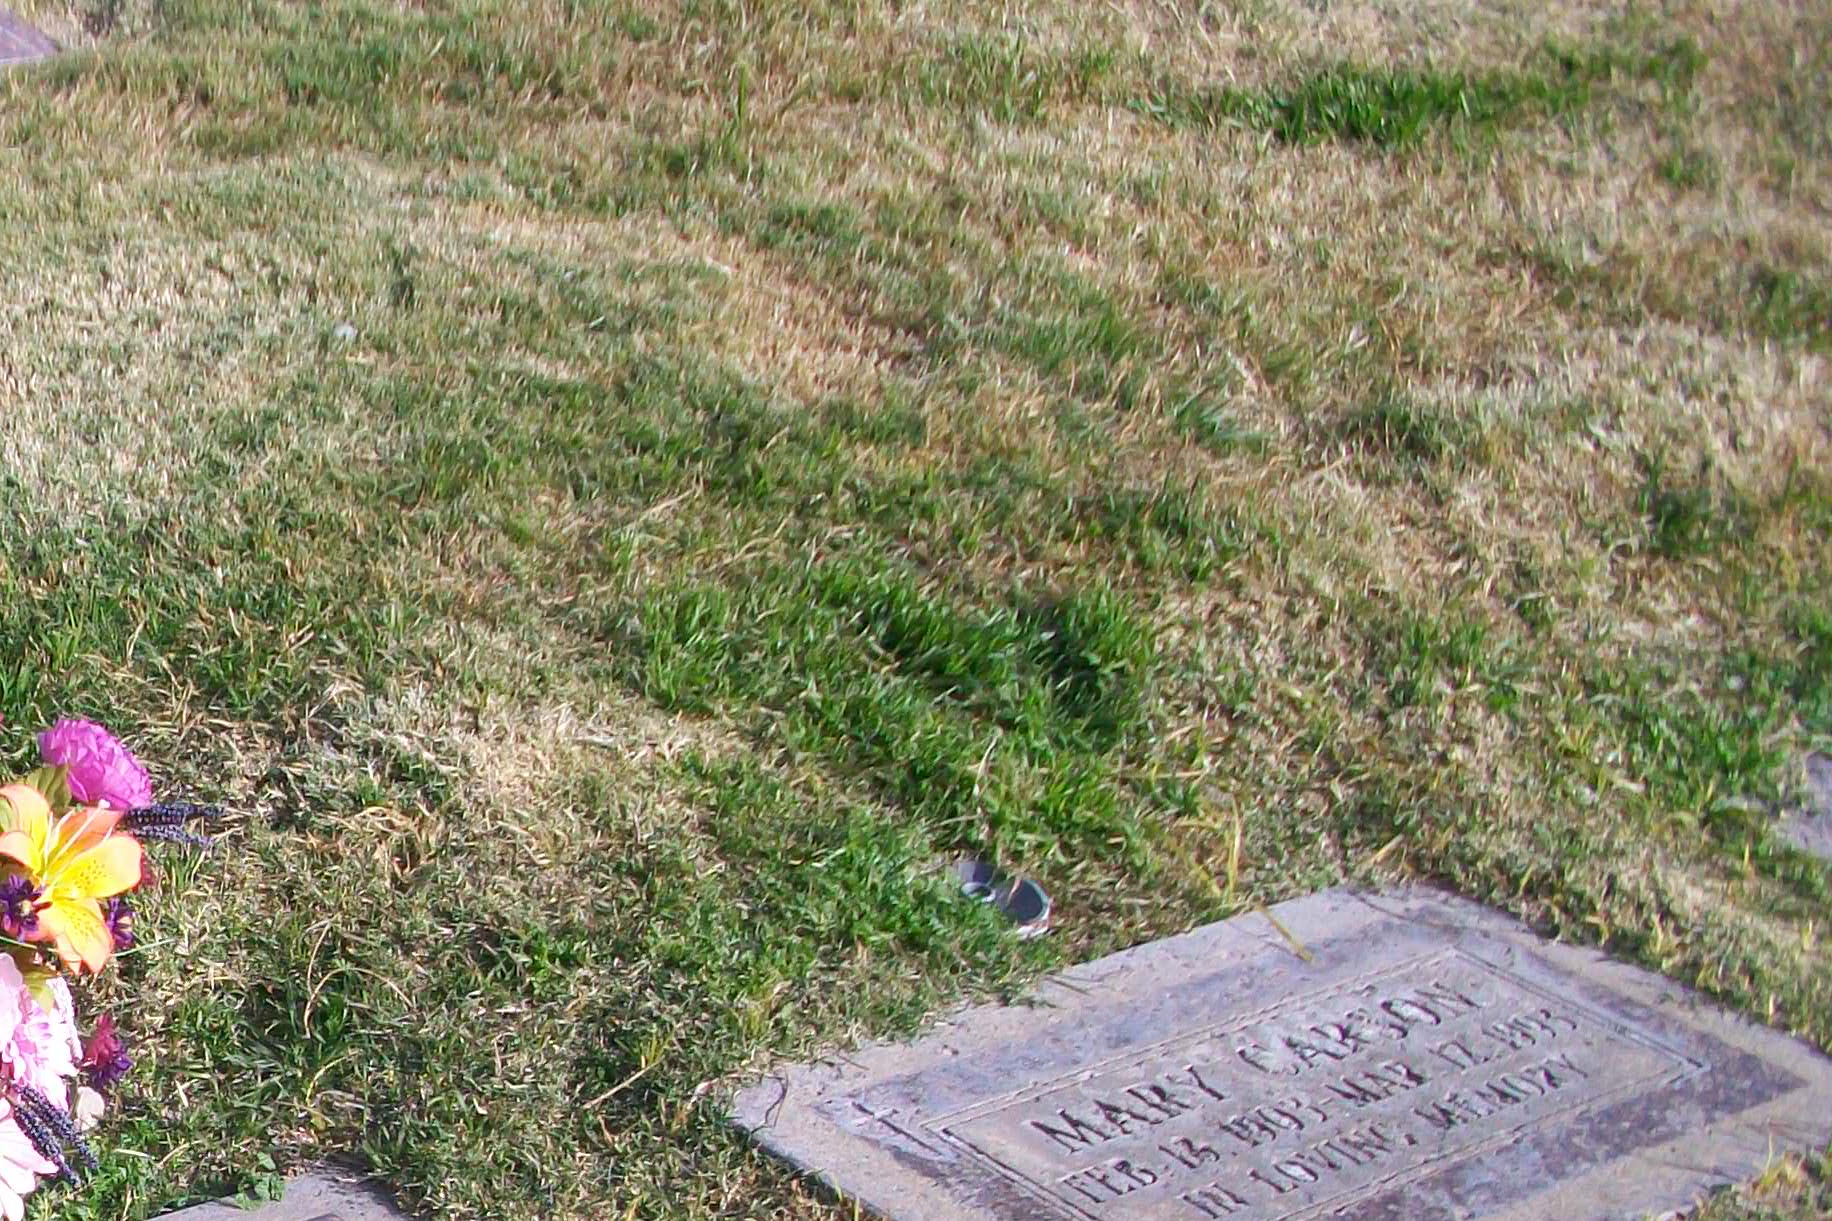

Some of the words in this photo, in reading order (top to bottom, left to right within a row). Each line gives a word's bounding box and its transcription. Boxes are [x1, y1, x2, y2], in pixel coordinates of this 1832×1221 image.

[1030, 1063, 1226, 1154] MARY
[1237, 980, 1482, 1077] CARSON
[1178, 1181, 1251, 1219] IN
[1246, 1124, 1417, 1194] LOVING
